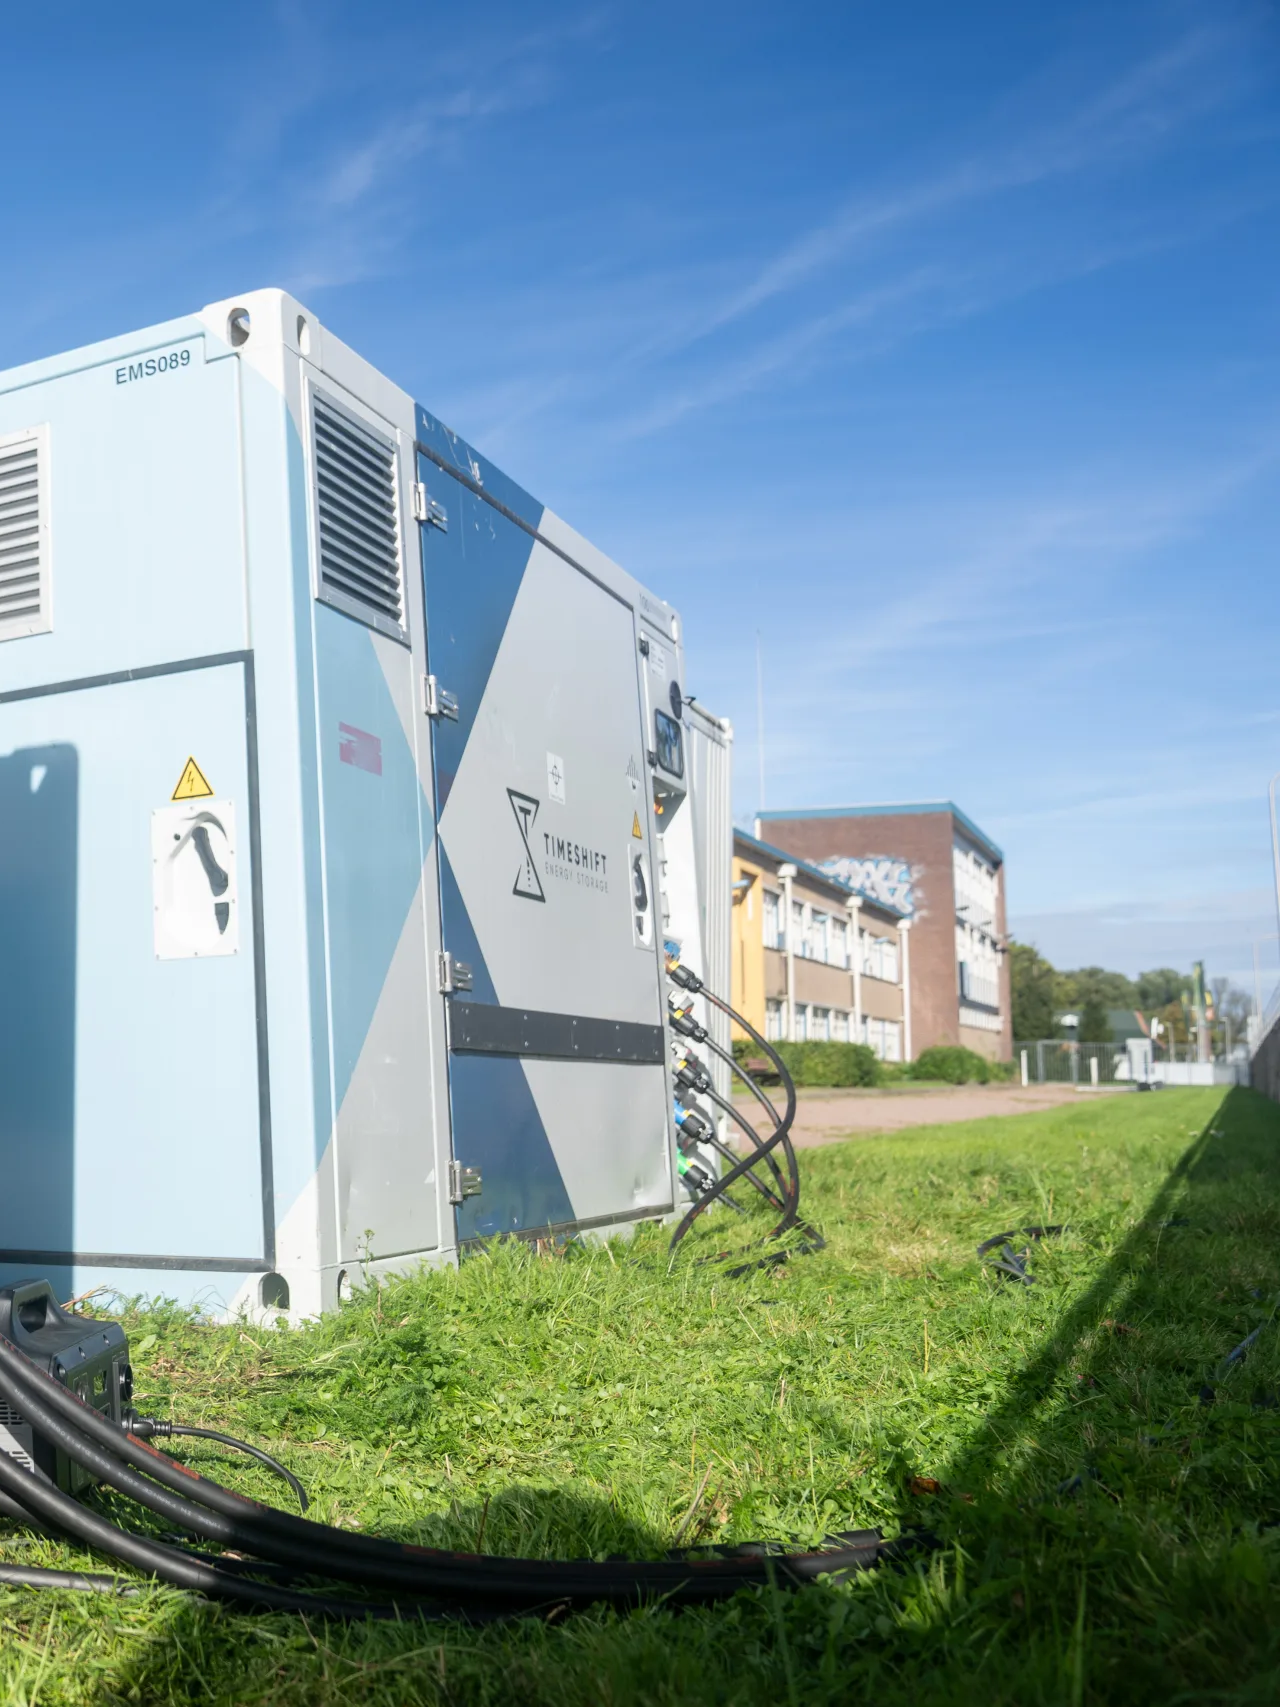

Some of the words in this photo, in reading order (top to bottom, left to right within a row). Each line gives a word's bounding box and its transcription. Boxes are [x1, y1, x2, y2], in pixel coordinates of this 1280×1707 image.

[116, 349, 190, 385] EMS089
[543, 832, 606, 875] TIMESHIFT
[545, 861, 573, 881] ENERGY
[576, 872, 608, 893] STORAGE
